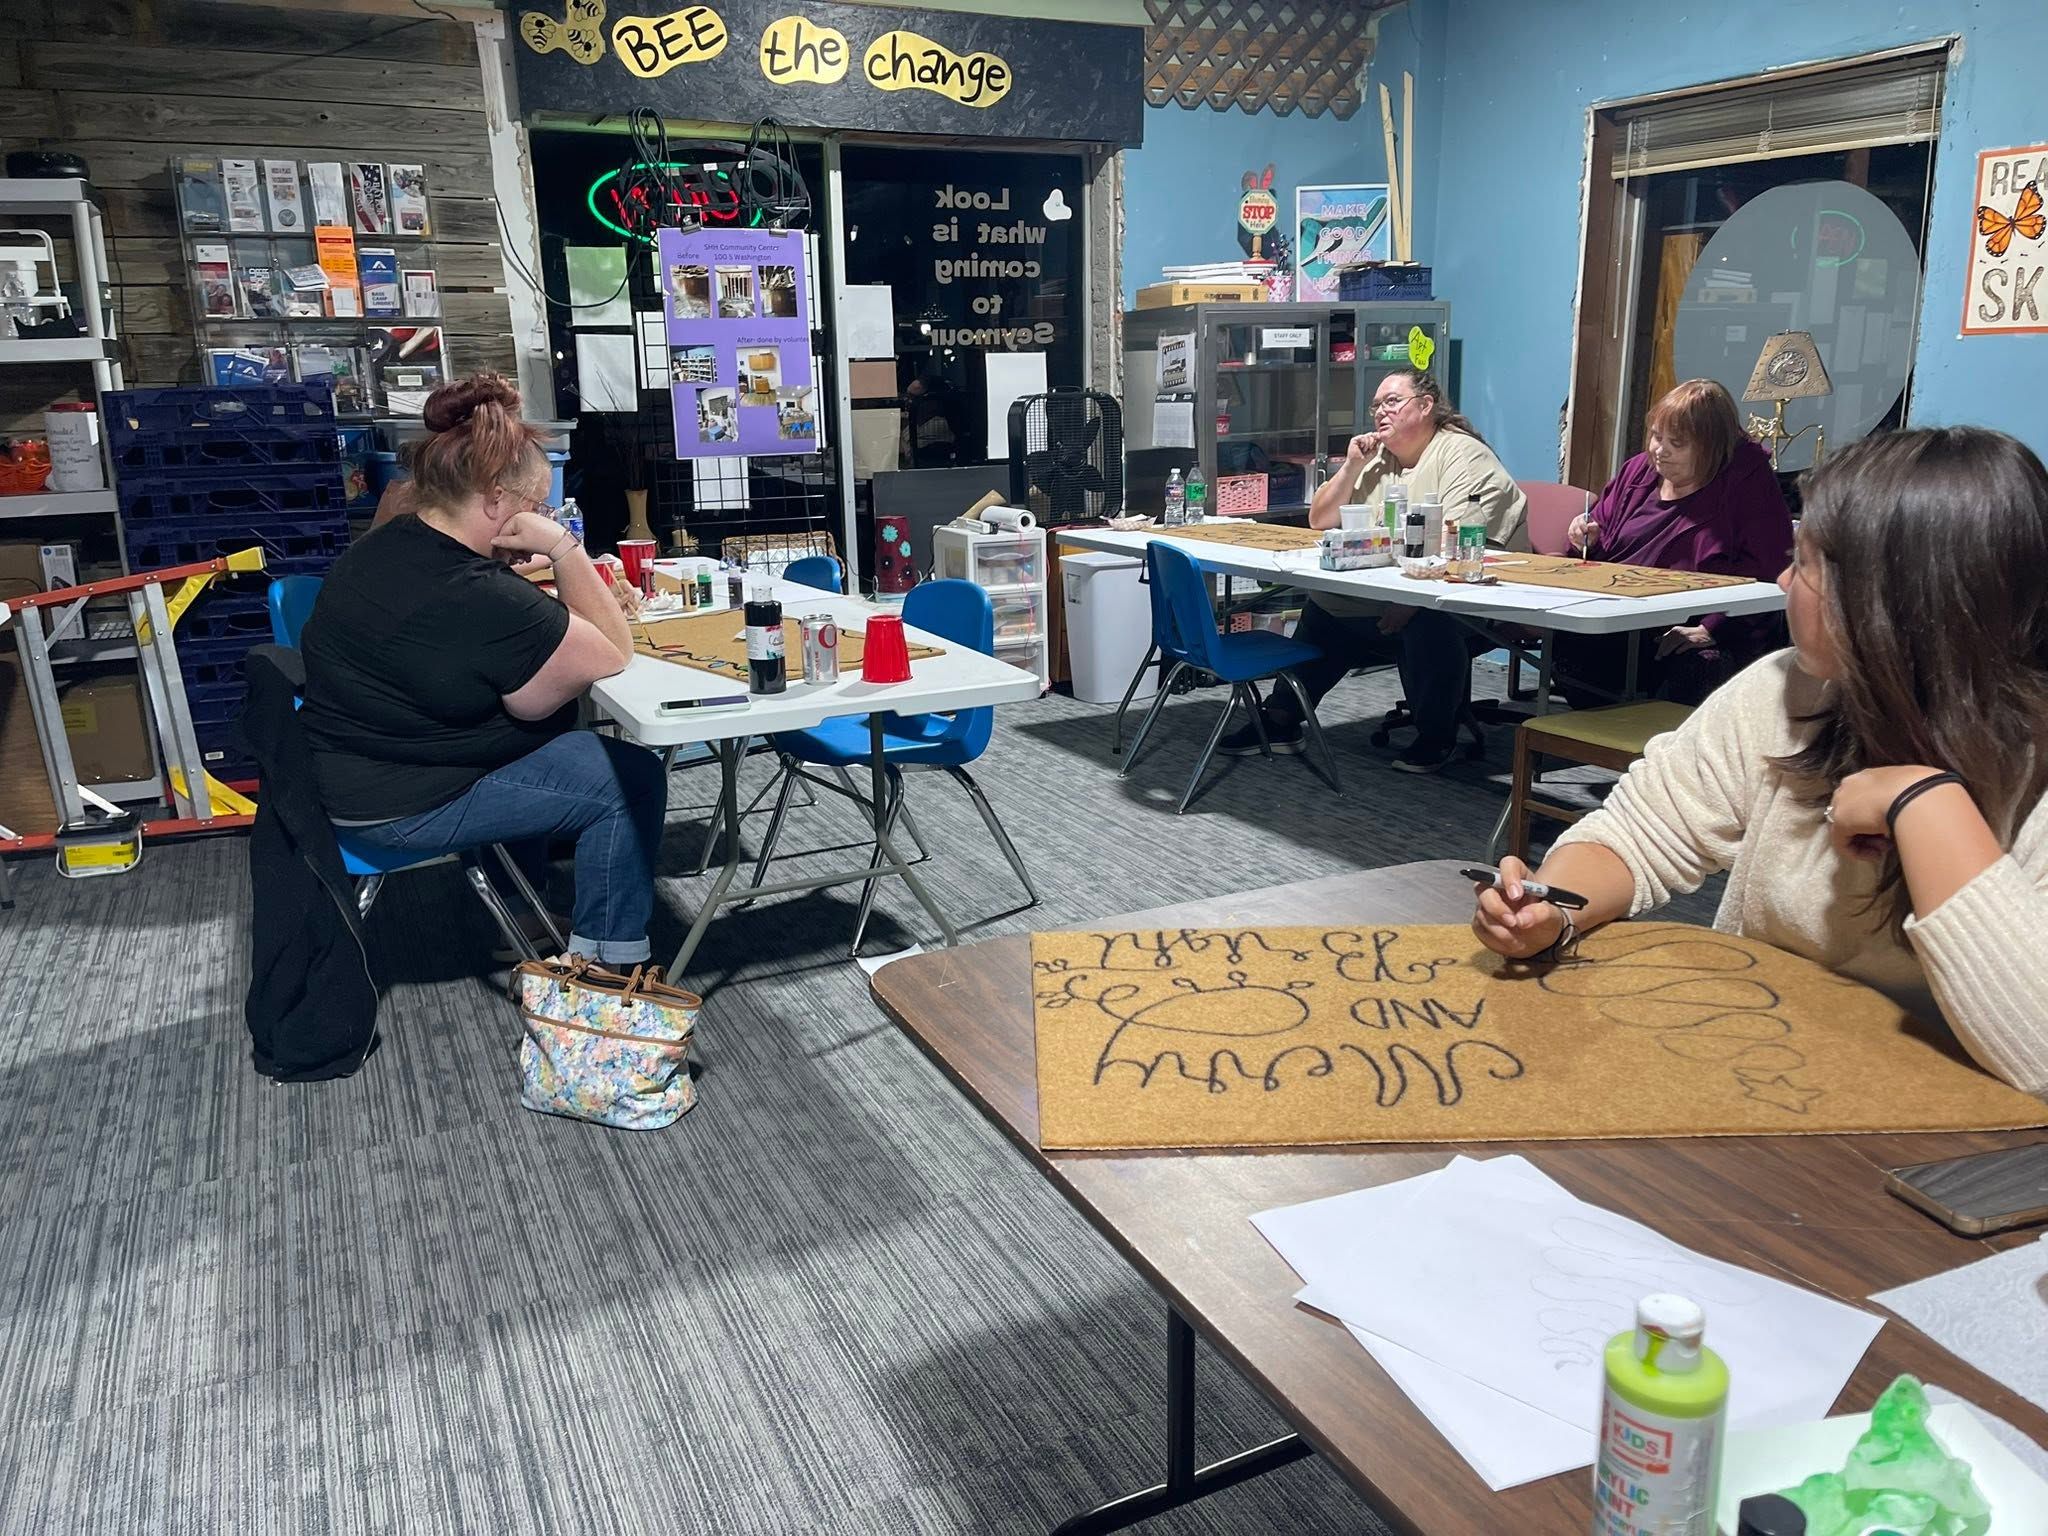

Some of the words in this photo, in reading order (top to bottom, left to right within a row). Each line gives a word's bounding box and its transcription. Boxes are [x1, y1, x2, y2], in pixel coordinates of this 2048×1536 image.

[616, 8, 725, 72] BEE
[764, 22, 842, 75] the
[868, 34, 1006, 102] change
[1242, 205, 1275, 220] STOP
[1321, 204, 1367, 218] MAKE
[1249, 220, 1266, 229] Here
[1319, 226, 1367, 241] GOOD
[720, 243, 757, 252] Community
[758, 243, 780, 251] Center
[677, 252, 700, 260] Before
[714, 253, 728, 261] 100
[734, 253, 772, 262] Washington
[1316, 249, 1373, 265] THINGS
[757, 336, 773, 344] done
[773, 336, 782, 345] by
[1092, 928, 1458, 983] Bright
[1350, 997, 1486, 1031] AND
[1092, 1015, 1524, 1108] Merry
[1613, 1422, 1660, 1456] KIDS
[1597, 1482, 1636, 1518] AINT
